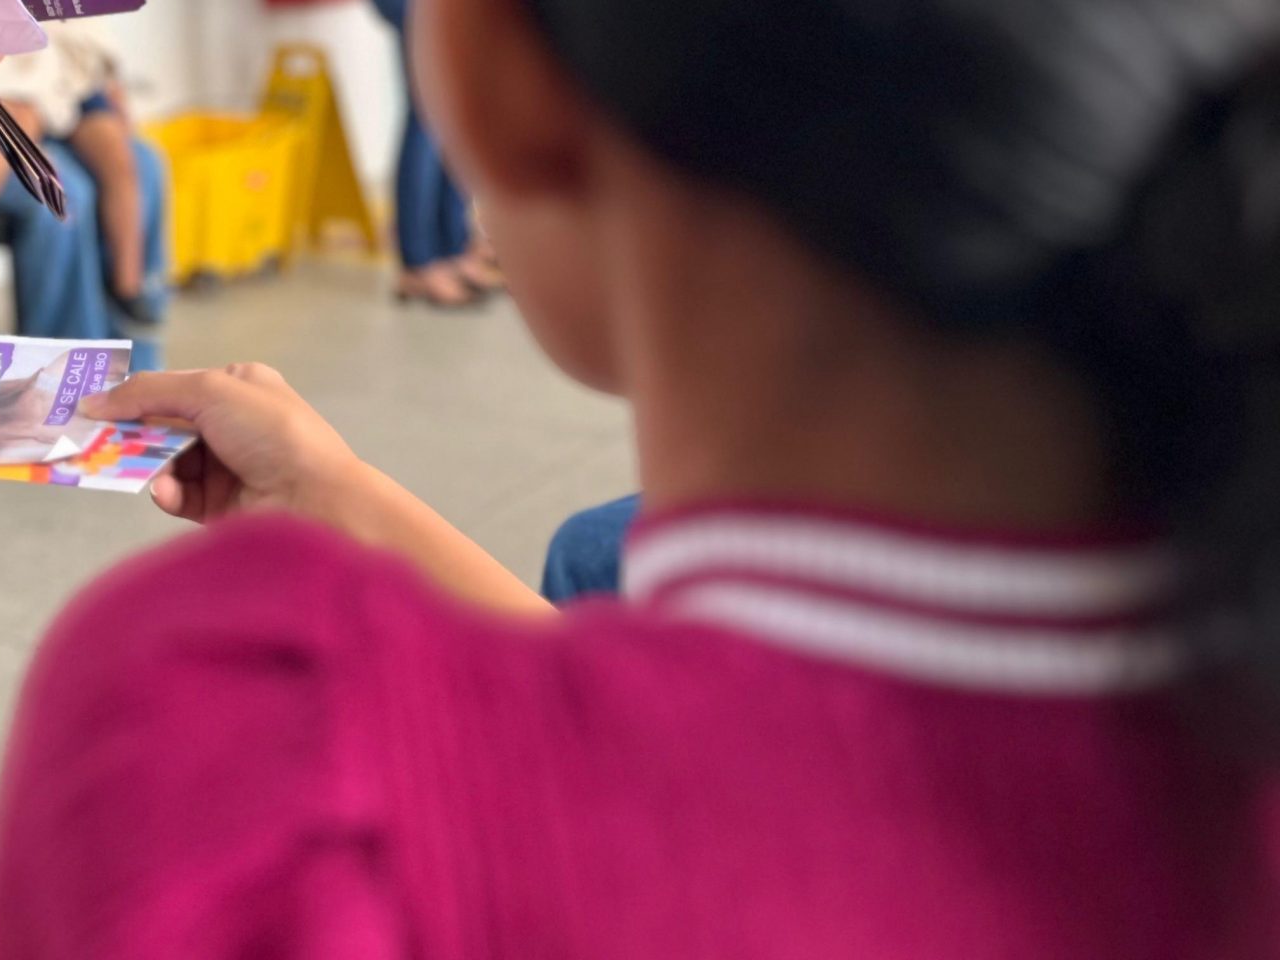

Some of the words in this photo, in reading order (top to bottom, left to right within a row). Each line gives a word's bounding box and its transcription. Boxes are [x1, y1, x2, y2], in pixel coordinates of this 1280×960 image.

[66, 352, 88, 385] CALE
[94, 352, 108, 371] 180
[60, 387, 77, 404] SE
